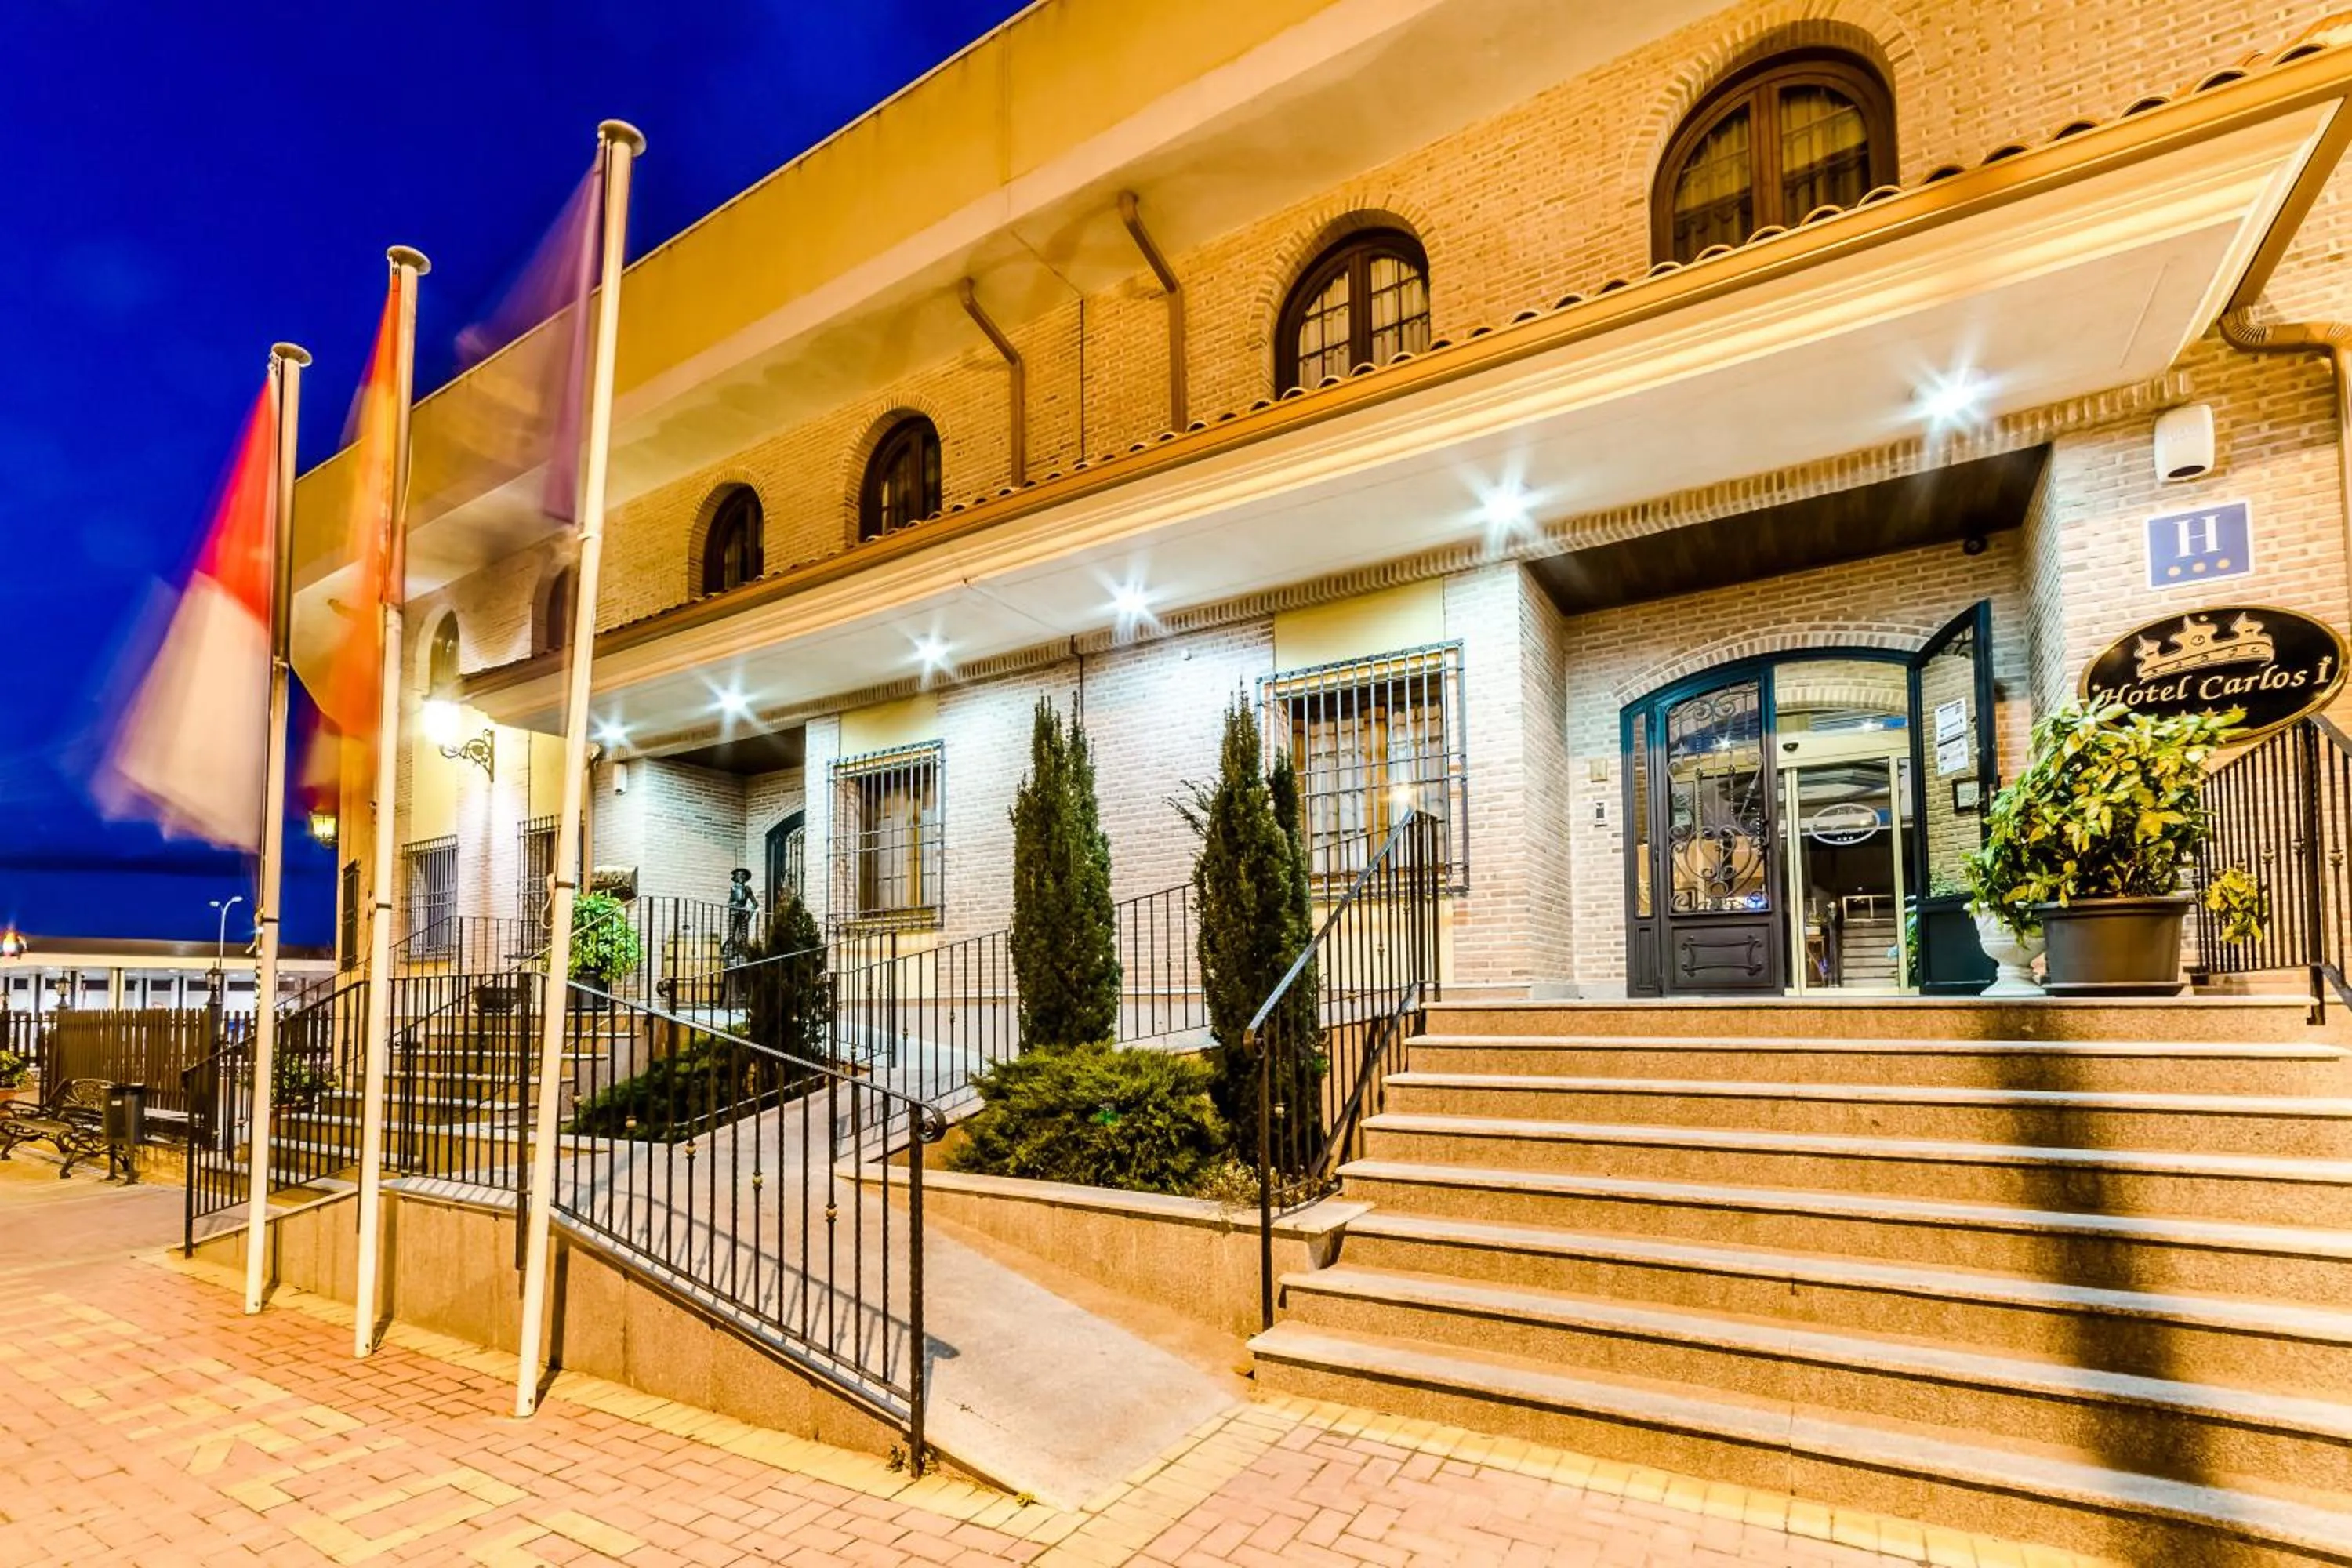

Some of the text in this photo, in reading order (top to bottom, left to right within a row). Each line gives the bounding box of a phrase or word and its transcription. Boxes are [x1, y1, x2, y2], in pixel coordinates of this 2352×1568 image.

[2174, 514, 2221, 559] H
[2096, 675, 2193, 709] Hotel
[2198, 664, 2309, 701] Carlos
